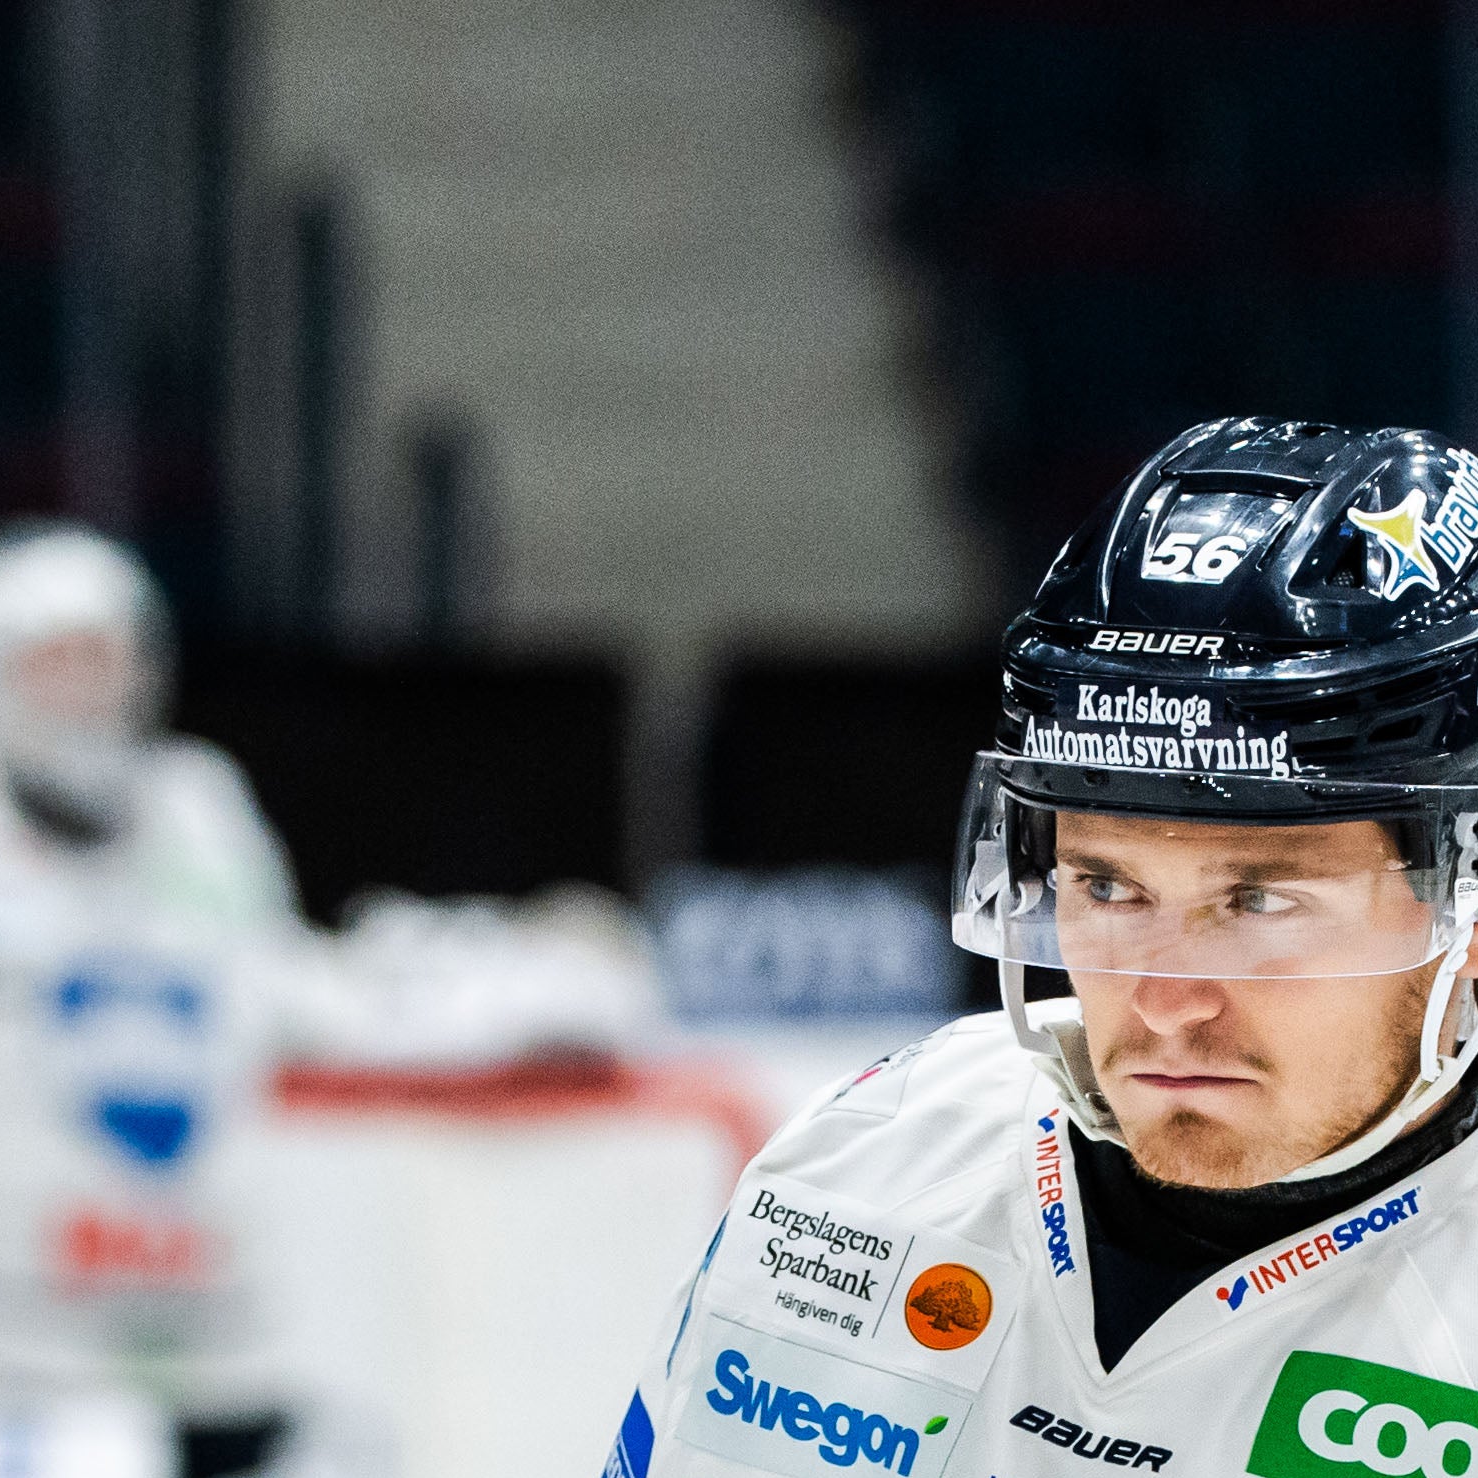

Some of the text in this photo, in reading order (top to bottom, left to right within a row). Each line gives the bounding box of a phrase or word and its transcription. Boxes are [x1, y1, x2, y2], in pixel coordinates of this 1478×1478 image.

[1149, 534, 1246, 581] 56
[1089, 629, 1225, 656] BAUER
[1076, 684, 1211, 737] Karlskoga
[1022, 714, 1290, 780] Automatsvarvning
[747, 1189, 893, 1261] Bergslagens
[1036, 1135, 1077, 1278] INTERSPORT
[759, 1237, 879, 1302] Sparbank
[1249, 1187, 1421, 1294] INTERSPORT
[775, 1289, 864, 1338] Hängiven dig
[705, 1348, 920, 1478] Swegon
[1009, 1404, 1173, 1475] BAUER
